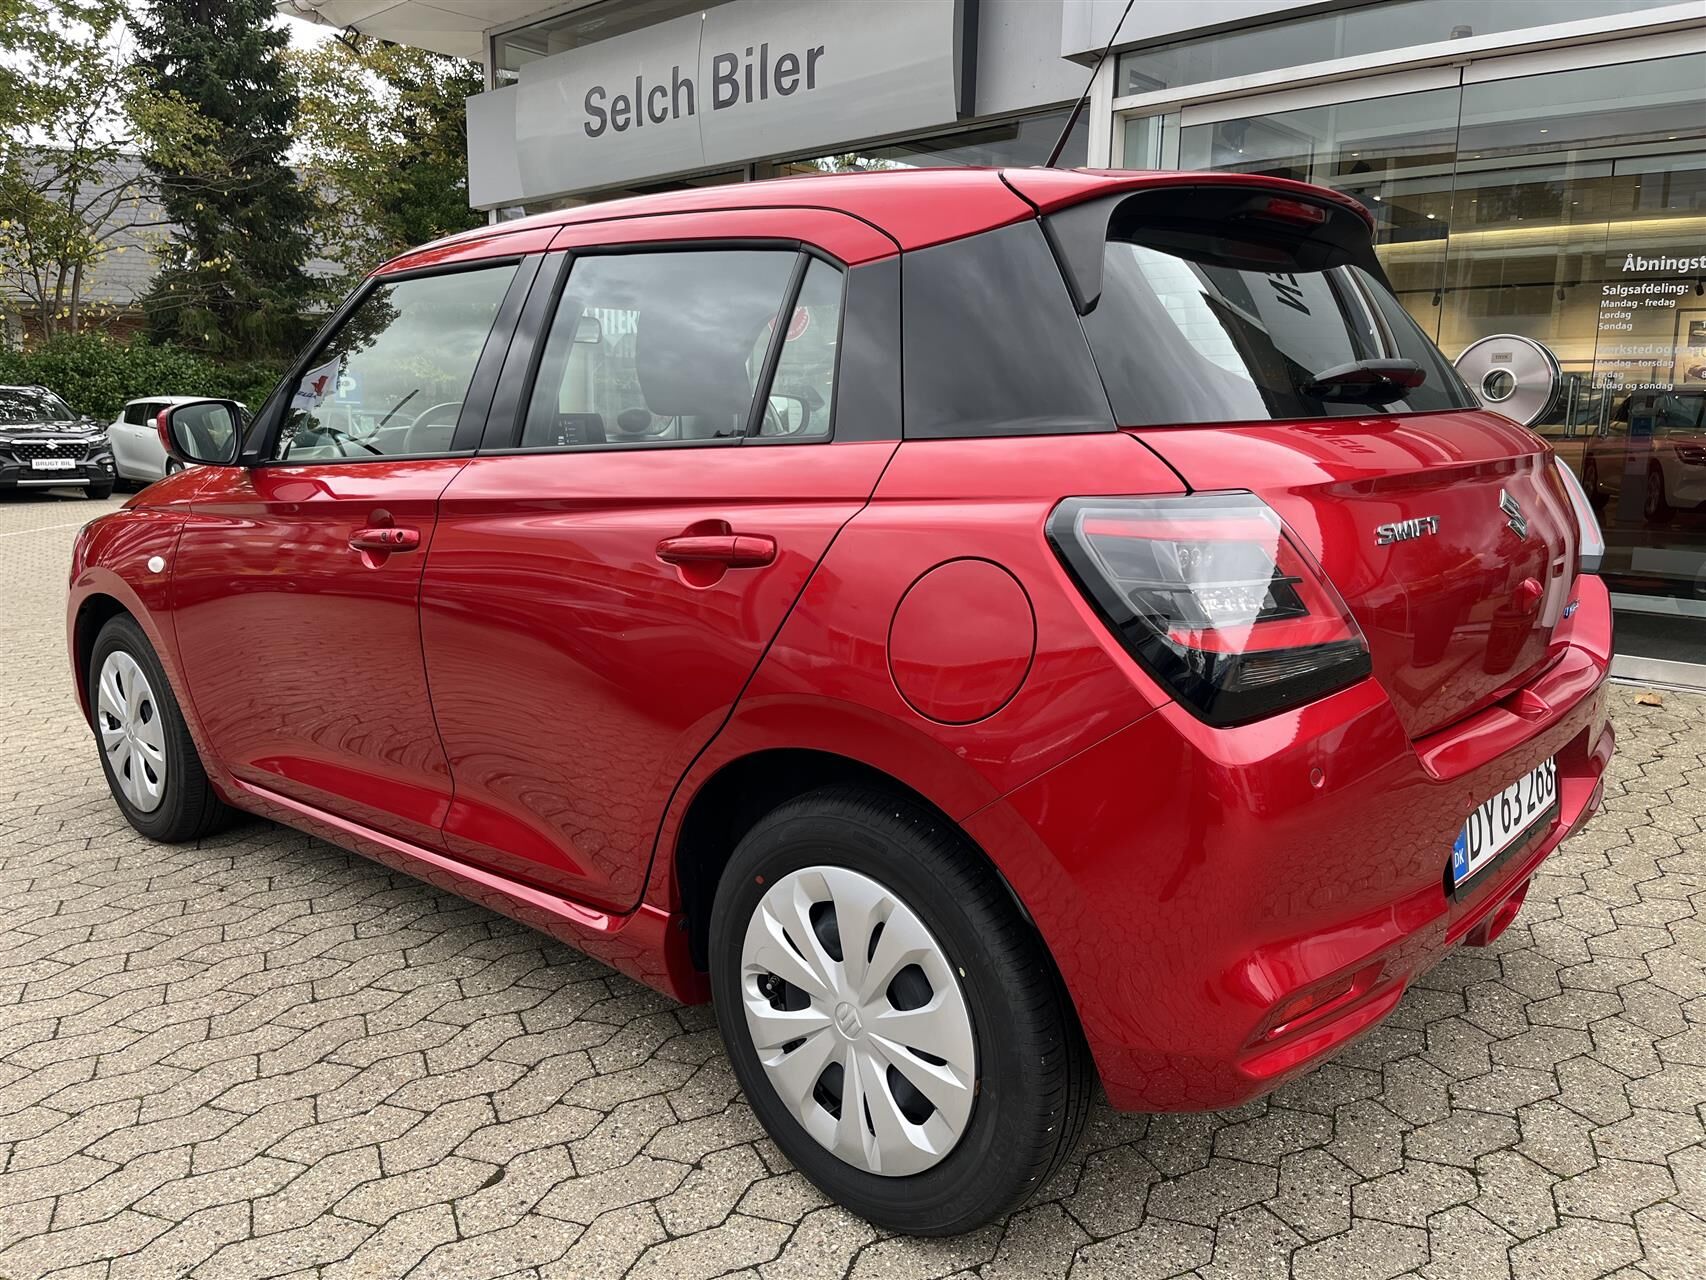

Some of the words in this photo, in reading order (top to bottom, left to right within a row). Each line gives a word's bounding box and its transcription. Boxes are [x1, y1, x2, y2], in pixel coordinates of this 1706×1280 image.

[584, 65, 695, 138] Selch
[712, 43, 824, 110] Biler
[1602, 283, 1689, 297] Salgsafdeling:
[1600, 300, 1638, 309] Mandag
[1645, 298, 1676, 308] fredag
[1599, 311, 1632, 320] Lørdag
[1598, 322, 1633, 332] Søndag
[1638, 359, 1675, 368] torsdag
[1625, 383, 1637, 391] og
[1639, 382, 1674, 391] søndag
[1375, 515, 1441, 545] SWIFT
[1469, 799, 1494, 861] DY
[1501, 781, 1522, 834] 63
[1527, 757, 1554, 815] 268
[1454, 848, 1465, 868] DK
